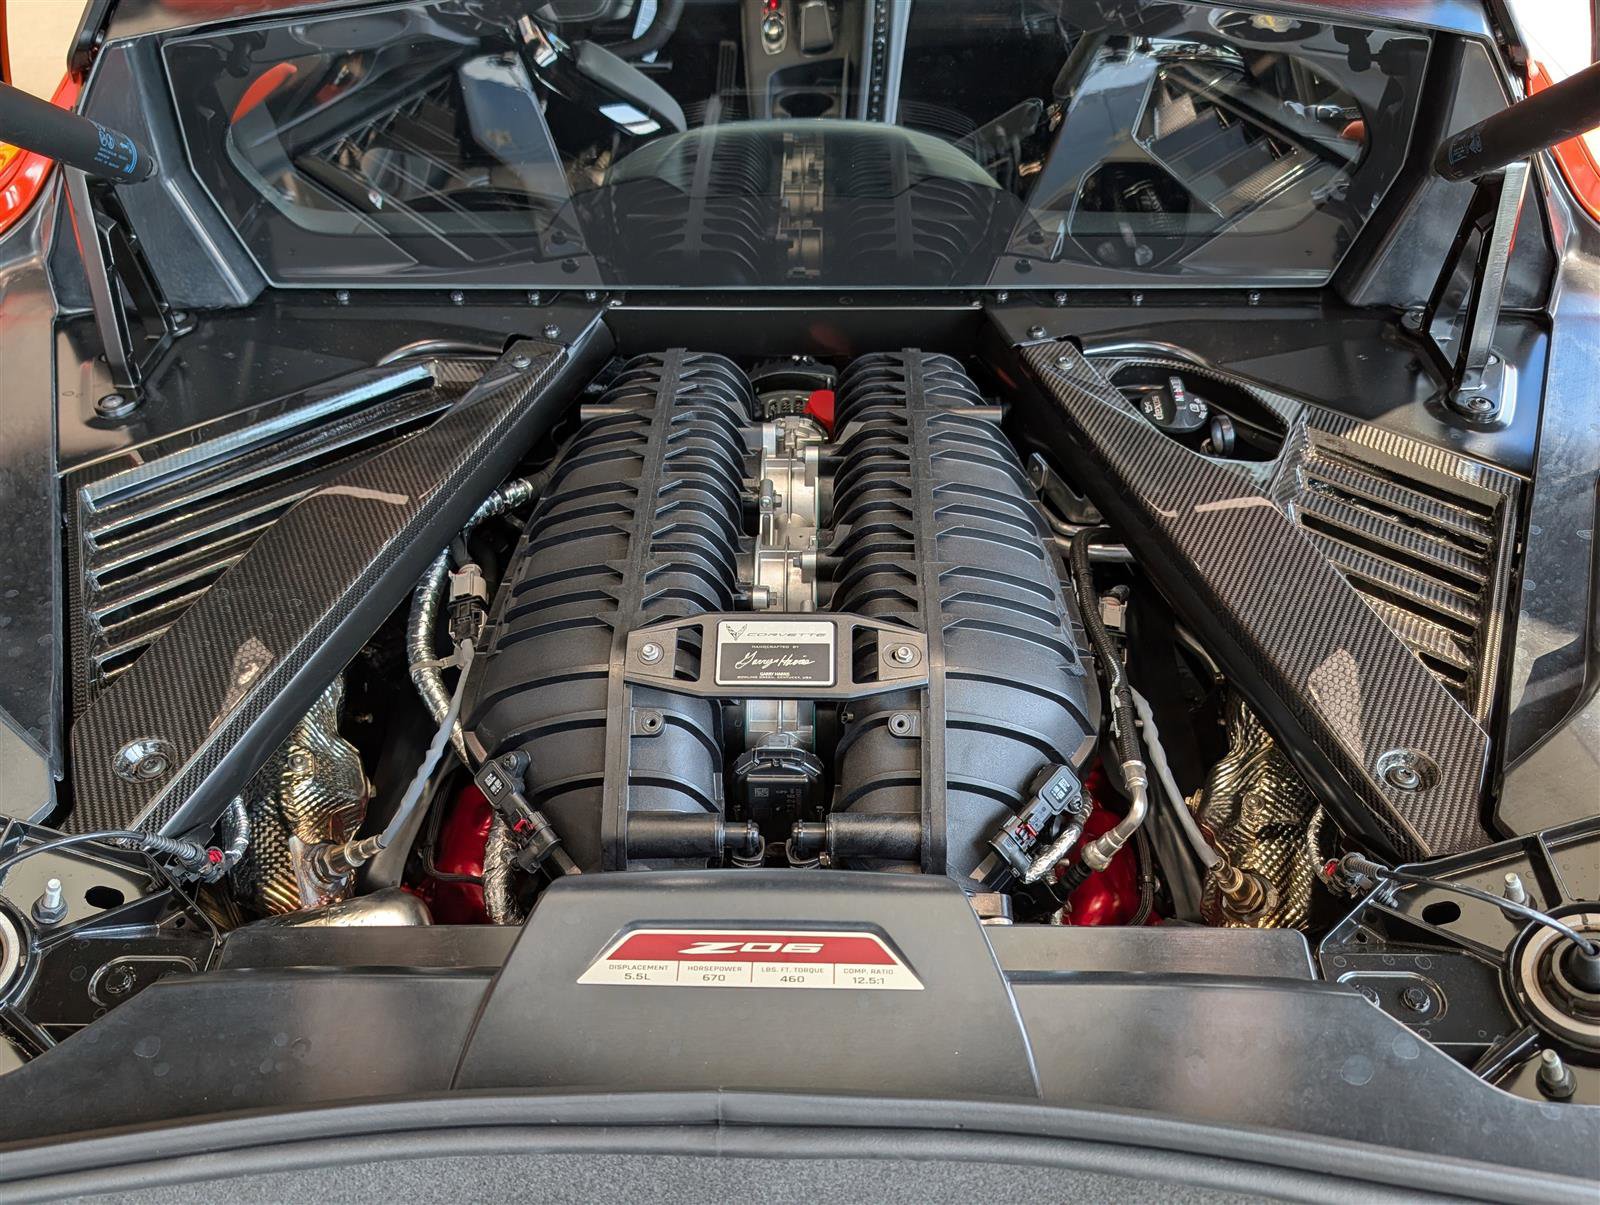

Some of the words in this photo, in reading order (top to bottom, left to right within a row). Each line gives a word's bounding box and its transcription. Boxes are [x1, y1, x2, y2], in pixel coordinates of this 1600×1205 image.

[678, 942, 824, 954] Z06
[624, 972, 650, 981] 5.5L
[702, 973, 725, 982] 670
[780, 974, 804, 983] 460
[852, 976, 885, 984] 12.5:1
